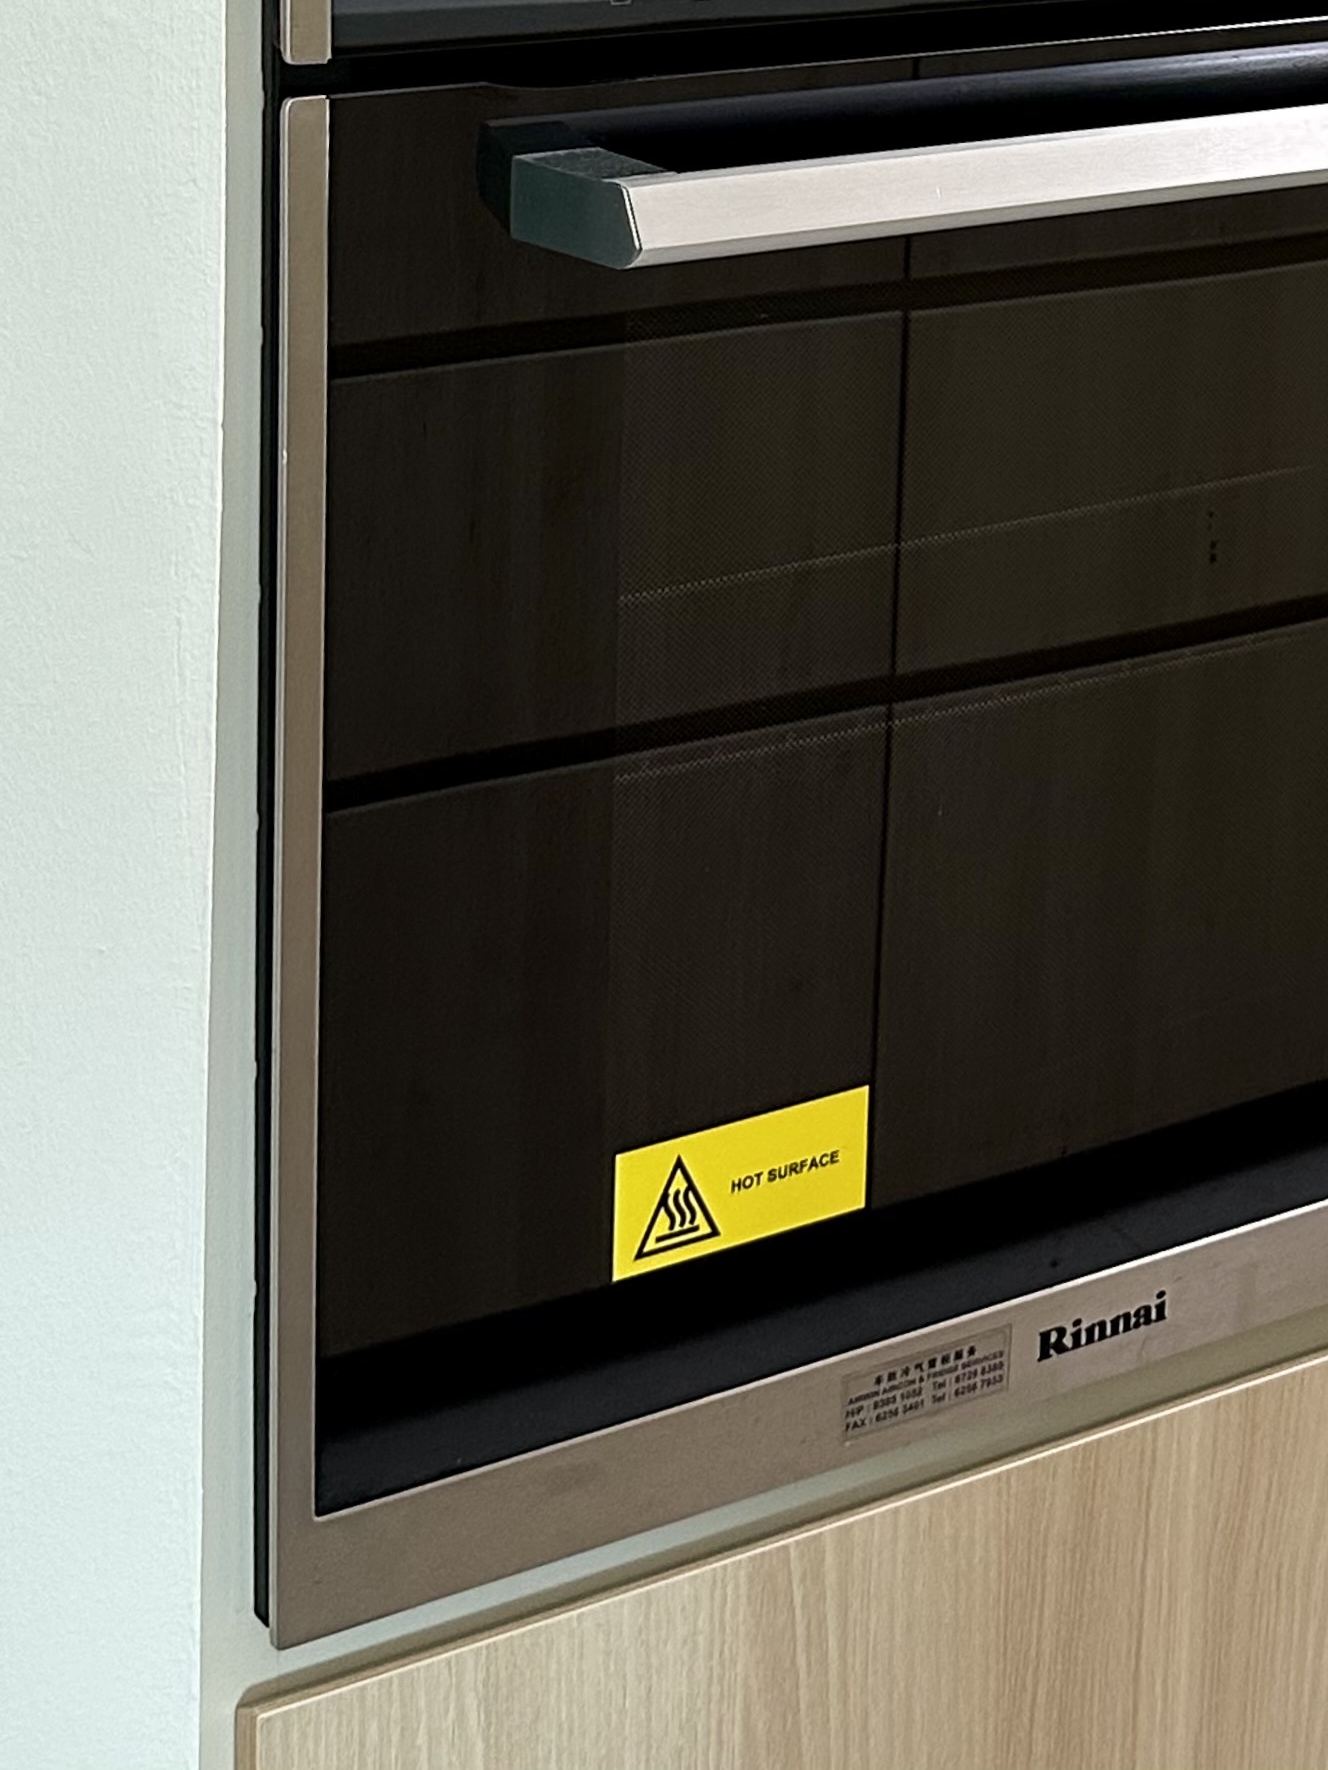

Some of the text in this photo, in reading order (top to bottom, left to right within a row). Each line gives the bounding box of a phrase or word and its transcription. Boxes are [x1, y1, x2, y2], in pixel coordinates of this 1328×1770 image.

[731, 1150, 840, 1194] HOT SURFACE
[1037, 1290, 1167, 1362] Rinnai
